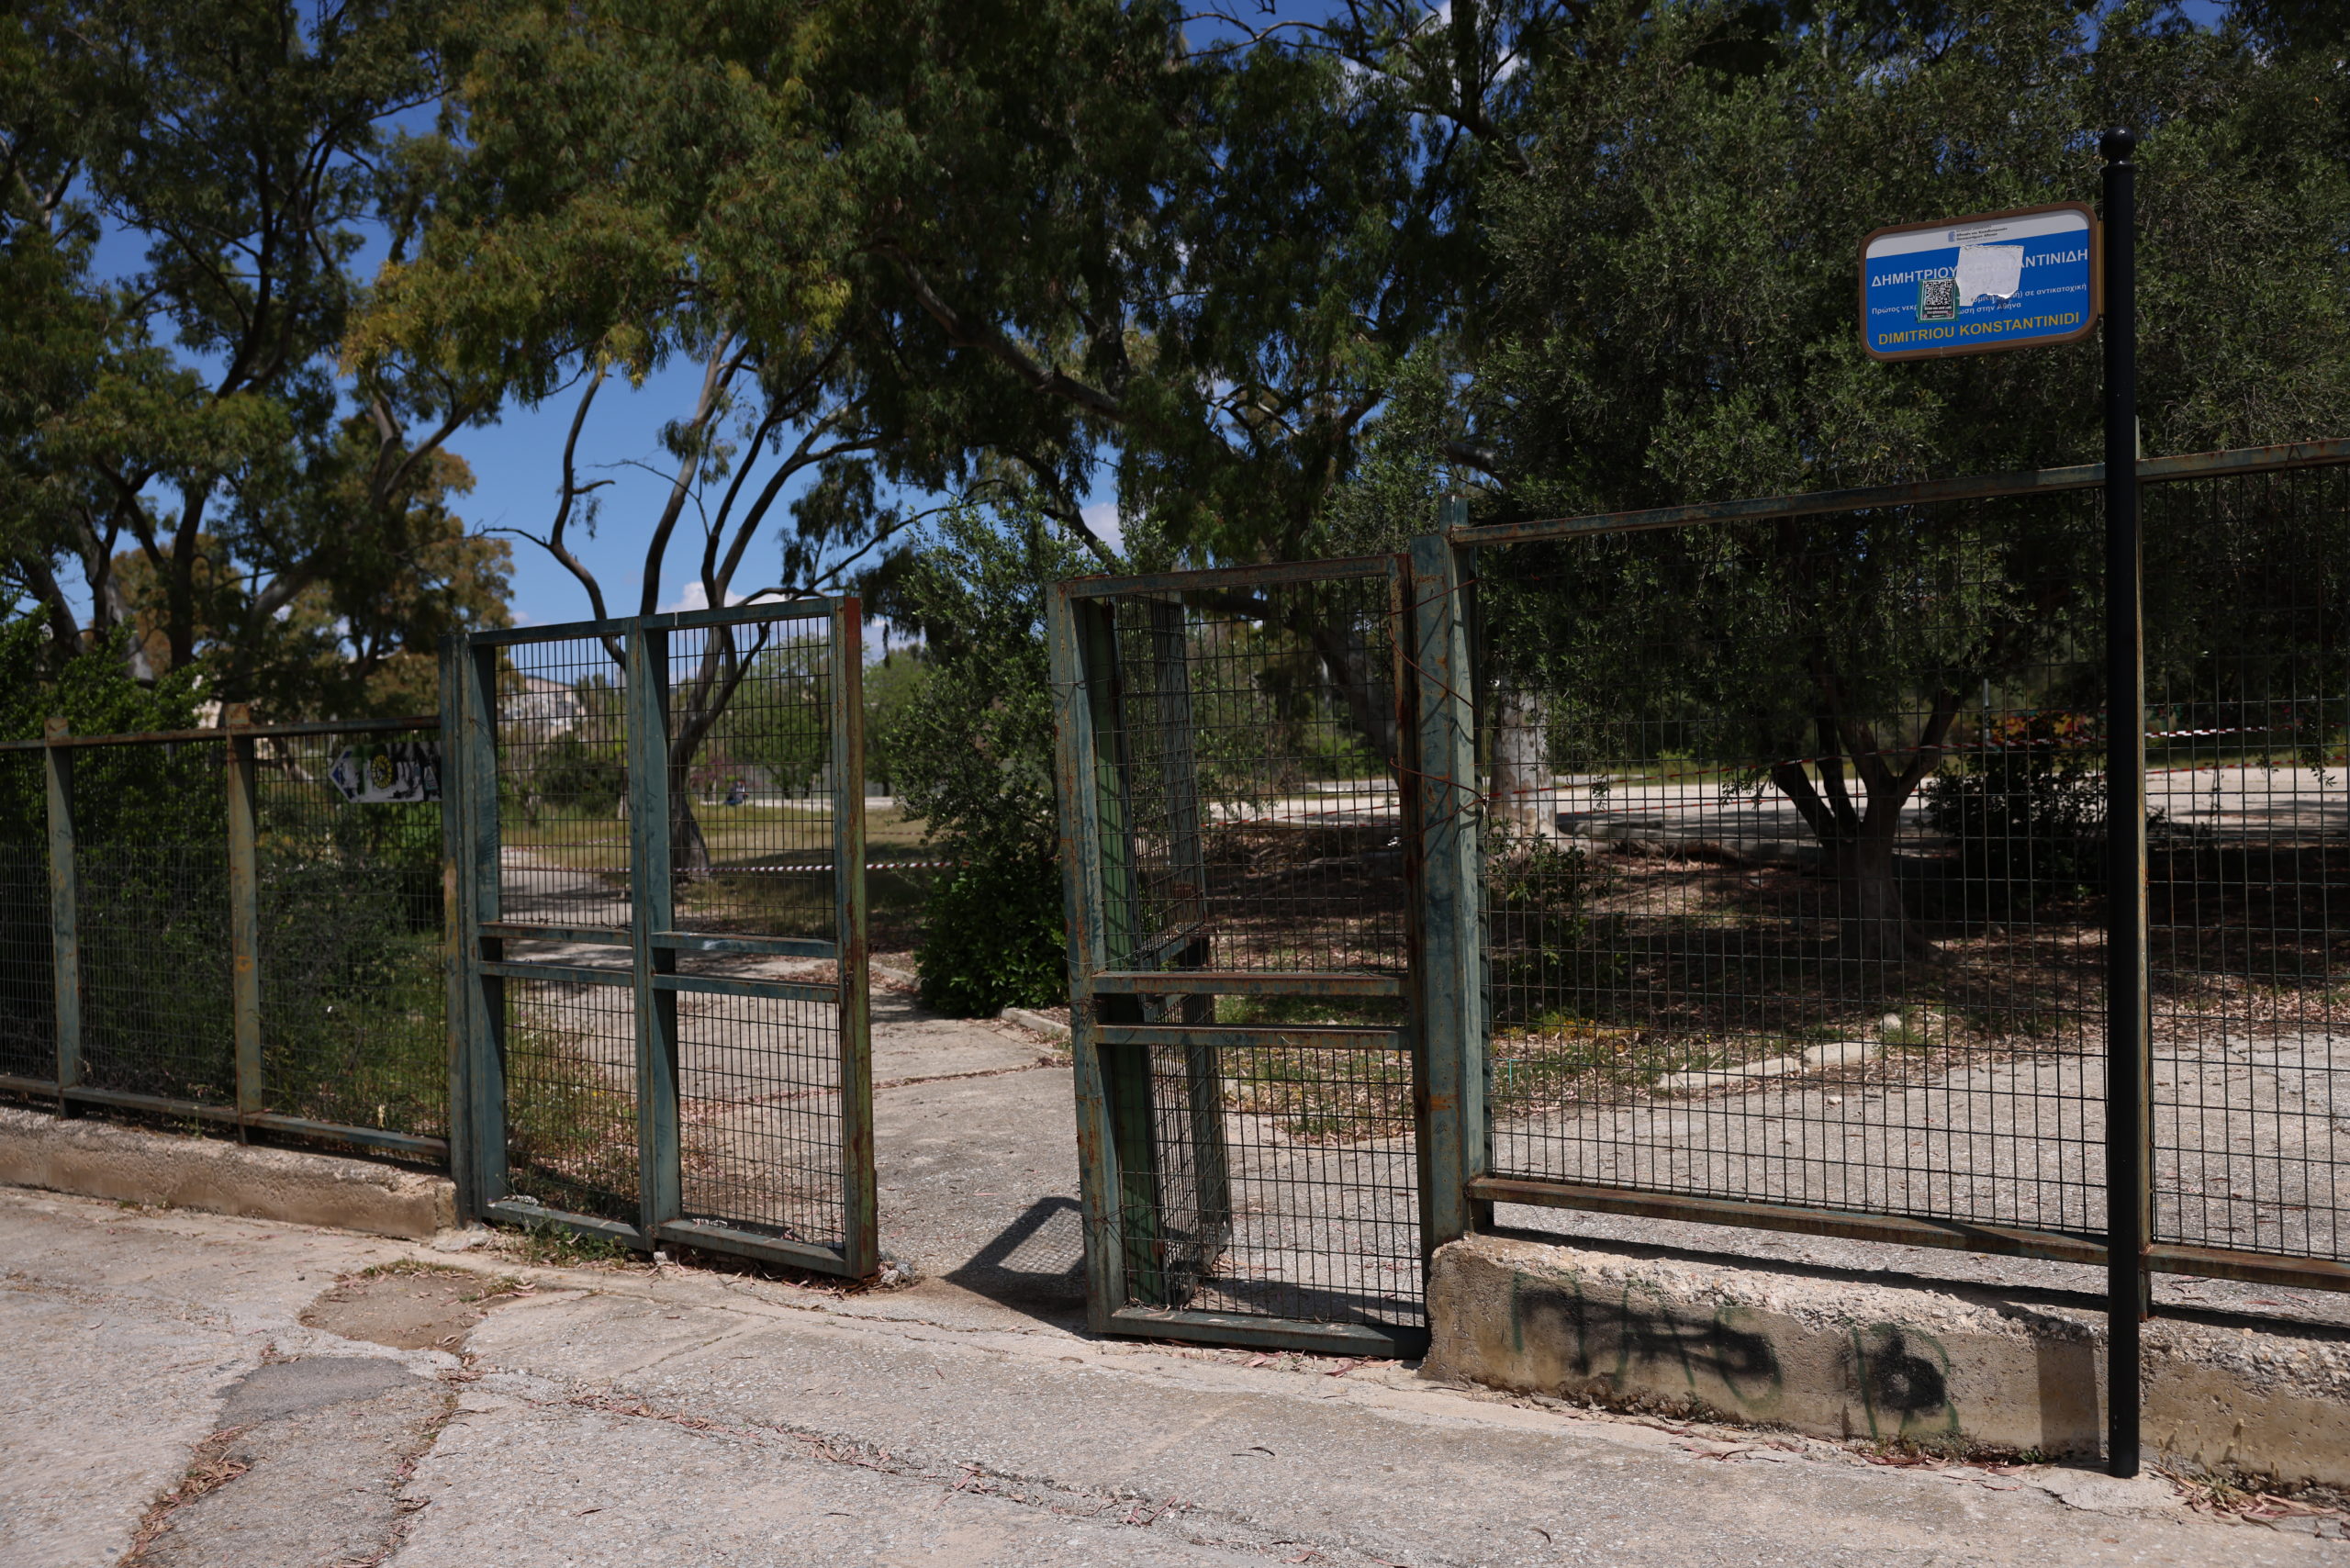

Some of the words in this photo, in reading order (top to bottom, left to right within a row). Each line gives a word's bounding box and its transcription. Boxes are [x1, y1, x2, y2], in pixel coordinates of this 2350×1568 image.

[1872, 266, 1957, 287] ΔΗΜΗΤΡΙΟΥ
[1872, 305, 1899, 316] Πρώτος
[2025, 288, 2034, 297] σε
[2037, 283, 2087, 297] αντικατοχική
[1976, 305, 1995, 315] στην
[1997, 302, 2021, 312] Αθήνα
[1878, 325, 1954, 345] DIMITRIOU
[1960, 311, 2080, 337] KONSTANTINIDI
